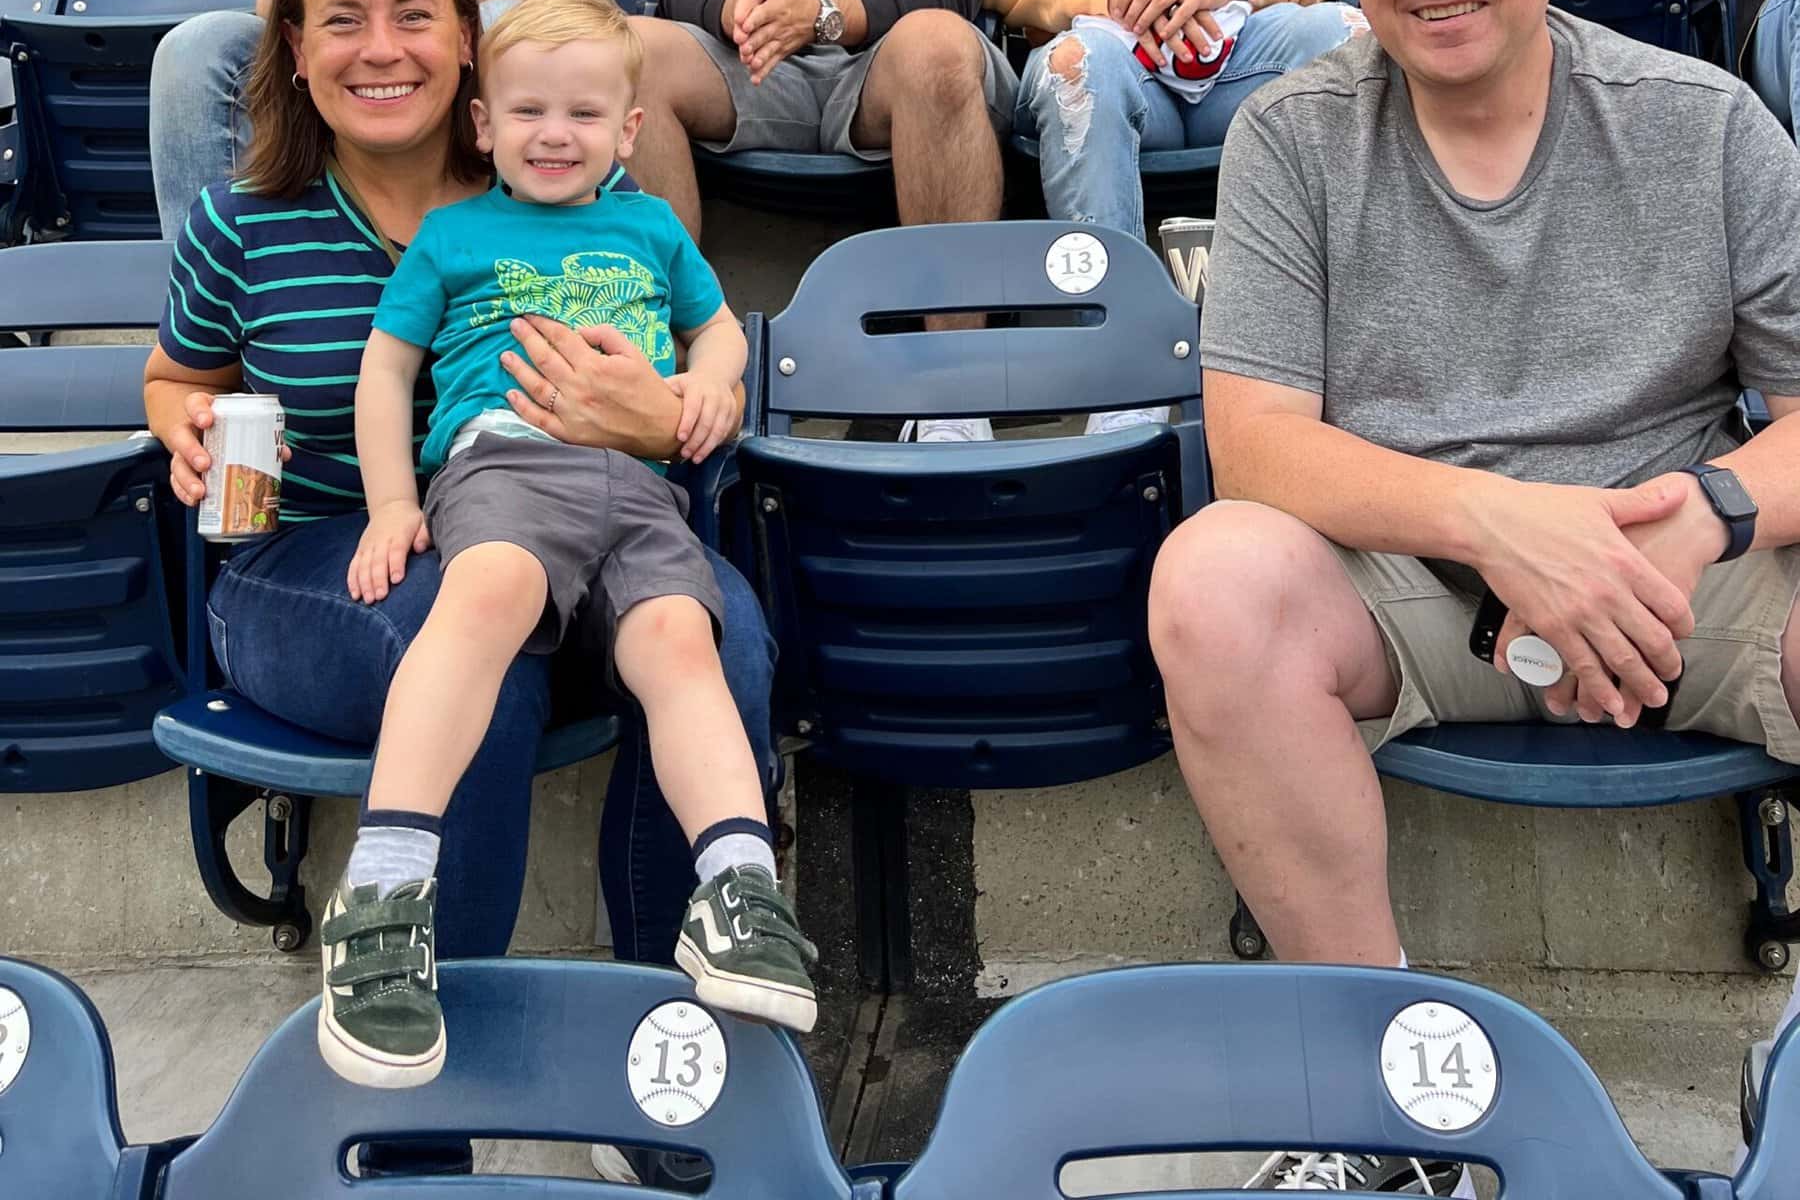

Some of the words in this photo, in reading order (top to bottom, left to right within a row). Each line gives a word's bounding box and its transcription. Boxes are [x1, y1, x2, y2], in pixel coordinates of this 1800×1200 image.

[1061, 251, 1093, 275] 13
[650, 1040, 702, 1087] 13
[1409, 1041, 1473, 1088] 14
